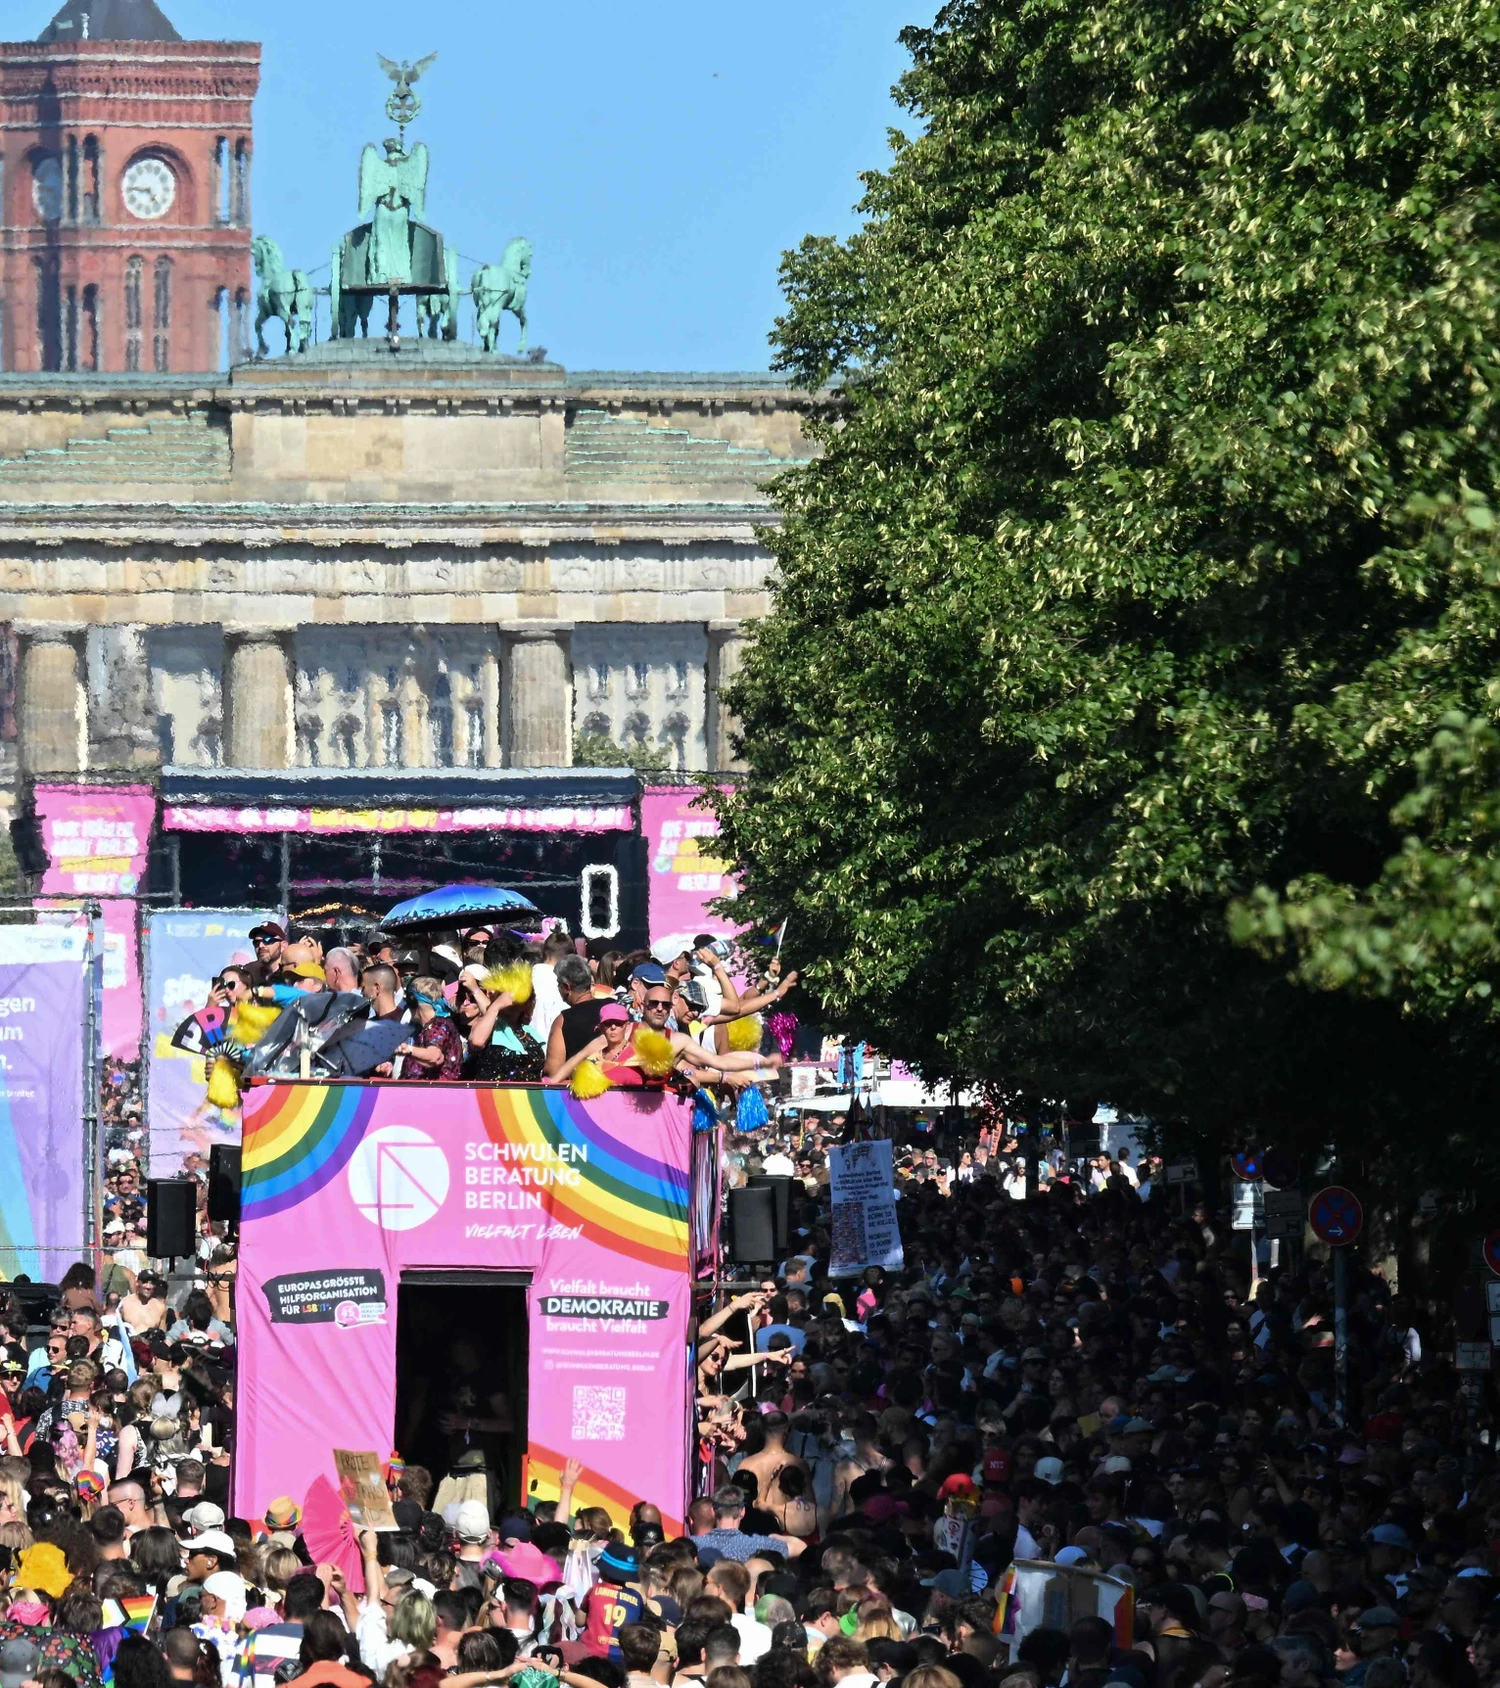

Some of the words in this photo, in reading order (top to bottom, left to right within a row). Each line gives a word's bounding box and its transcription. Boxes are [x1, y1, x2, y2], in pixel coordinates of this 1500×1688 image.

[464, 1142, 587, 1162] SCHWULEN
[465, 1167, 581, 1186] BERATUNG
[465, 1191, 541, 1209] BERLIN
[465, 1223, 536, 1239] VIELFALT
[278, 1281, 321, 1293] EUROPAS
[322, 1276, 365, 1288] GRÖSSTE
[549, 1279, 597, 1294] Vielfalt
[599, 1280, 650, 1296] braucht
[280, 1286, 377, 1304] HILFSORGANISATION
[282, 1304, 300, 1315] FÜR
[547, 1298, 659, 1316] DEMOKRATIE
[546, 1316, 597, 1332] braucht
[599, 1318, 647, 1334] Vielfalt
[604, 1603, 627, 1627] 19
